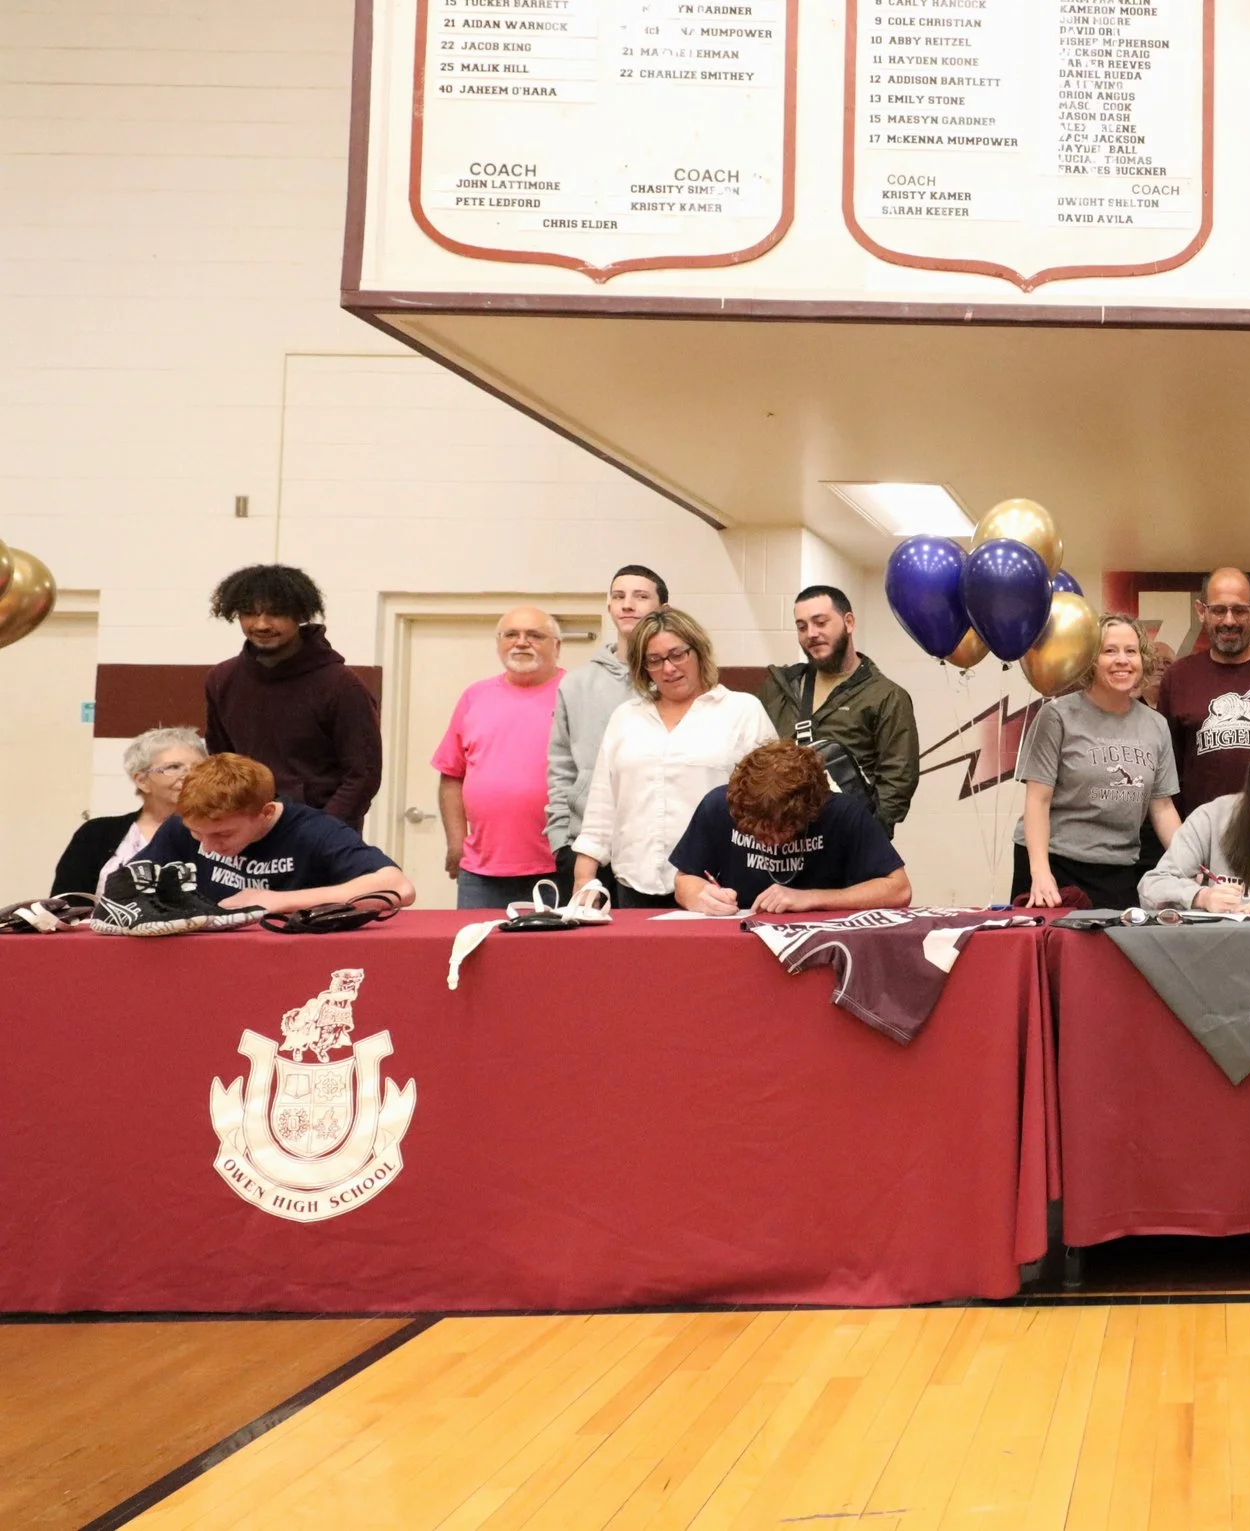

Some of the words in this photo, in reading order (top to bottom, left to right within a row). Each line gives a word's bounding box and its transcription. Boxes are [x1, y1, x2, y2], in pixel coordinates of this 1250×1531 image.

[513, 0, 569, 9] BARRETT
[932, 0, 986, 9] HANCOCK
[1060, 5, 1115, 15] KAMERON
[1120, 7, 1158, 16] MOORE
[443, 18, 455, 28] 21
[462, 18, 501, 30] AIDAN
[505, 20, 568, 32] WARNOCK
[874, 16, 882, 25] 9
[887, 17, 915, 26] COLE
[918, 17, 982, 28] CHRISTIAN
[700, 27, 773, 39] MUMPOWER
[440, 41, 455, 50] 22
[460, 41, 500, 51] JACOB
[503, 42, 532, 52] KING
[870, 36, 882, 45] 10
[888, 36, 922, 46] ABBY
[925, 37, 972, 47] REITZEL
[1103, 38, 1170, 49] McPHERSON
[622, 47, 634, 56] 21
[1116, 49, 1151, 59] CRAIG
[872, 55, 882, 64] 11
[888, 55, 938, 65] HAYDEN
[941, 56, 979, 67] KOONE
[1060, 58, 1104, 68] ARER
[1108, 59, 1151, 70] REEVES
[440, 62, 455, 72] 25
[460, 62, 500, 73] MALIK
[503, 64, 530, 74] HILL
[619, 69, 633, 78] 22
[639, 69, 697, 80] CHARLIZE
[700, 70, 755, 81] SMITHEY
[870, 75, 881, 84] 12
[887, 75, 937, 85] ADDISON
[940, 76, 1001, 87] BARTLETT
[1059, 69, 1101, 79] DANIEL
[1104, 70, 1142, 81] RUEDA
[438, 84, 453, 94] 40
[459, 85, 509, 96] JAHEEM
[512, 86, 557, 97] O'HARA
[1058, 90, 1092, 100] ORION
[1096, 91, 1136, 101] ANGUS
[869, 94, 881, 103] 13
[887, 94, 925, 104] EMILY
[928, 95, 966, 106] STONE
[1103, 102, 1132, 112] COOK
[869, 114, 881, 123] 15
[887, 114, 938, 125] MAESYN
[941, 116, 996, 126] GARDNER
[1058, 112, 1096, 121] JASON
[1099, 113, 1131, 122] DASH
[869, 134, 881, 143] 17
[887, 134, 944, 145] McKENNA
[946, 135, 1018, 147] MUMPOWER
[1092, 134, 1146, 145] JACKSON
[1108, 145, 1138, 155] BALL
[1058, 154, 1097, 164] UCIA
[469, 162, 537, 177] COACH
[674, 167, 740, 183] COACH
[455, 178, 488, 189] JOHN
[491, 179, 561, 191] LATTIMORE
[886, 173, 936, 187] COACH
[630, 183, 684, 195] CHASITY
[1131, 184, 1180, 196] COACH
[881, 190, 927, 200] KRISTY
[930, 191, 972, 201] KAMER
[455, 196, 486, 207] PETE
[488, 197, 541, 209] LEDFORD
[630, 200, 677, 212] KRISTY
[679, 202, 723, 213] KAMER
[1057, 197, 1105, 207] DWIGHT
[1108, 198, 1160, 209] SHELTON
[881, 205, 923, 215] SARAH
[926, 206, 970, 217] KEEFER
[542, 218, 578, 229] CHRIS
[581, 219, 619, 230] ELDER
[1057, 213, 1094, 224] DAVID
[1096, 214, 1134, 225] AVILA
[1088, 745, 1155, 772] TIGERS
[746, 852, 805, 873] WRESTLING
[222, 1157, 265, 1200] OWEN
[272, 1194, 319, 1214] HIGH
[329, 1160, 396, 1209] SCHOOL
